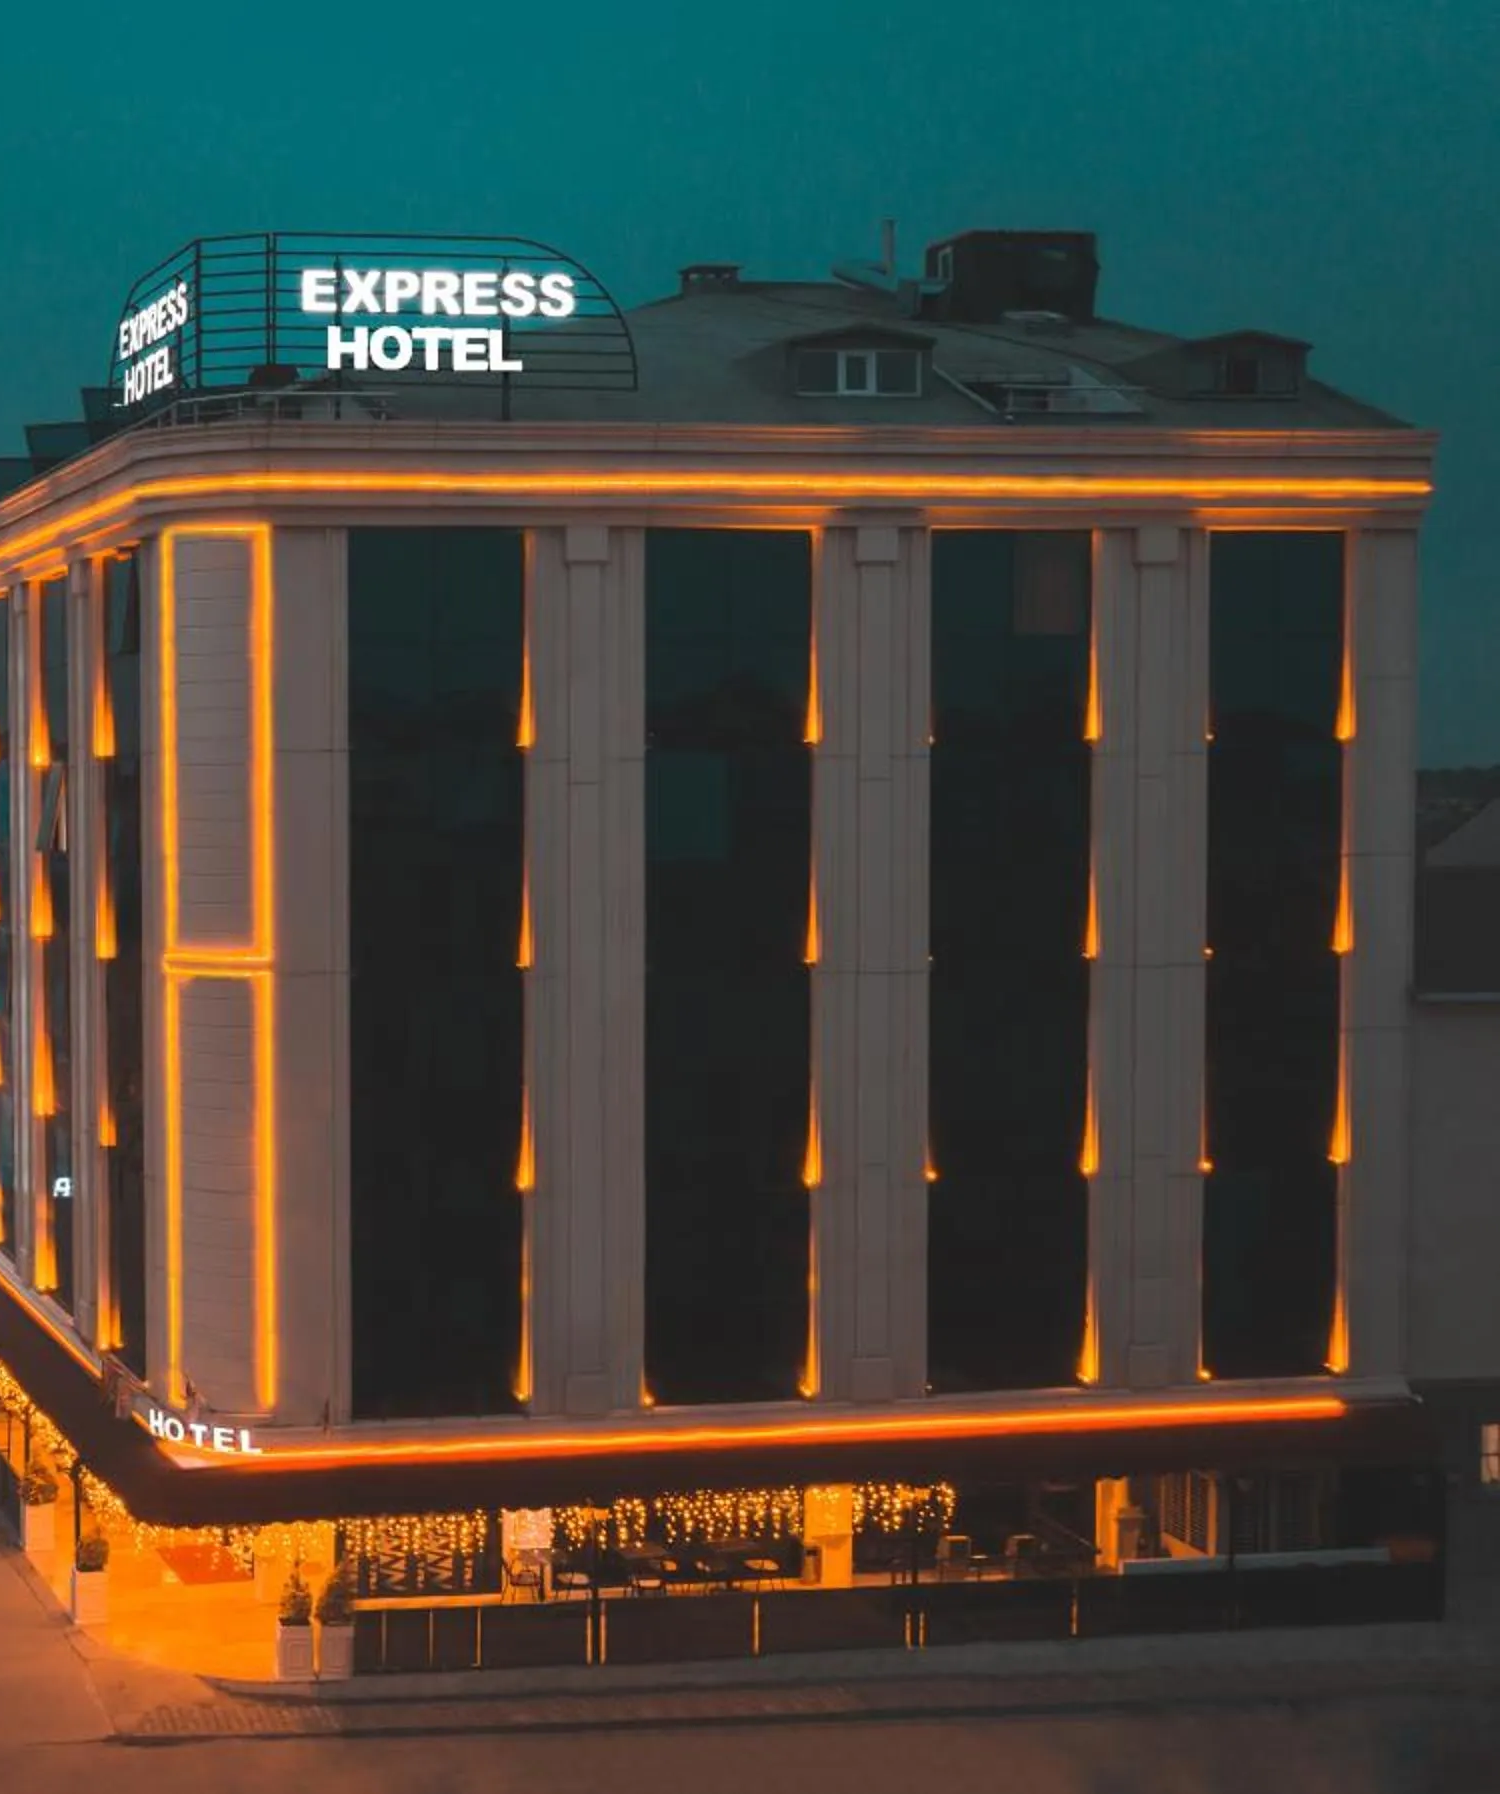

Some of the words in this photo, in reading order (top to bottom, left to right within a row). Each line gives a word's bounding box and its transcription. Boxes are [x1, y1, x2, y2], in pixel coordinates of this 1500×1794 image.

[299, 266, 576, 318] EXPRESS
[118, 281, 188, 361] EXPRESS
[326, 325, 523, 372] HOTEL
[124, 345, 174, 406] HOTEL
[148, 1408, 263, 1454] HOTEL
